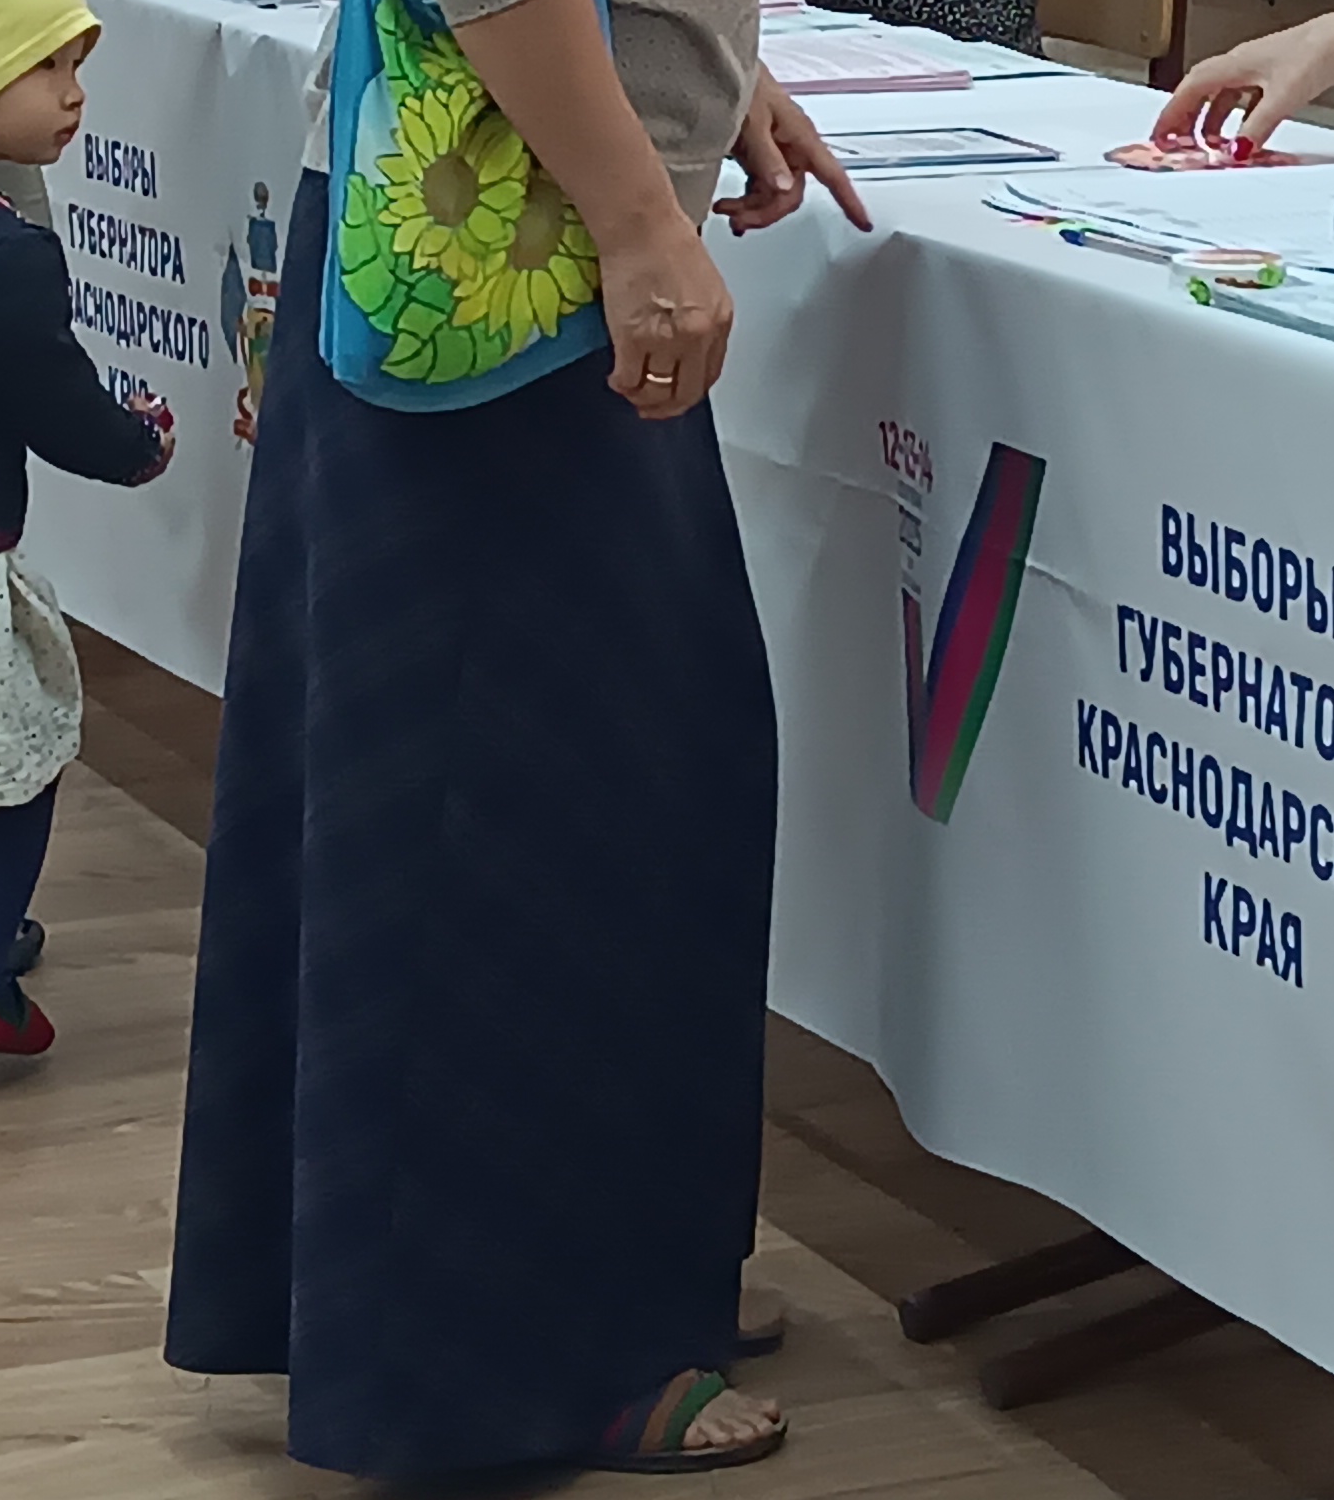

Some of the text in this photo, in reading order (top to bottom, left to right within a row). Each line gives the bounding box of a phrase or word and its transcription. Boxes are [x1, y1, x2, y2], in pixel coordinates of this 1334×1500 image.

[84, 133, 157, 199] ВЫБОРЫ
[68, 203, 186, 285] ГУБЕРНАТОРА
[1203, 871, 1304, 989] КРАЯ
